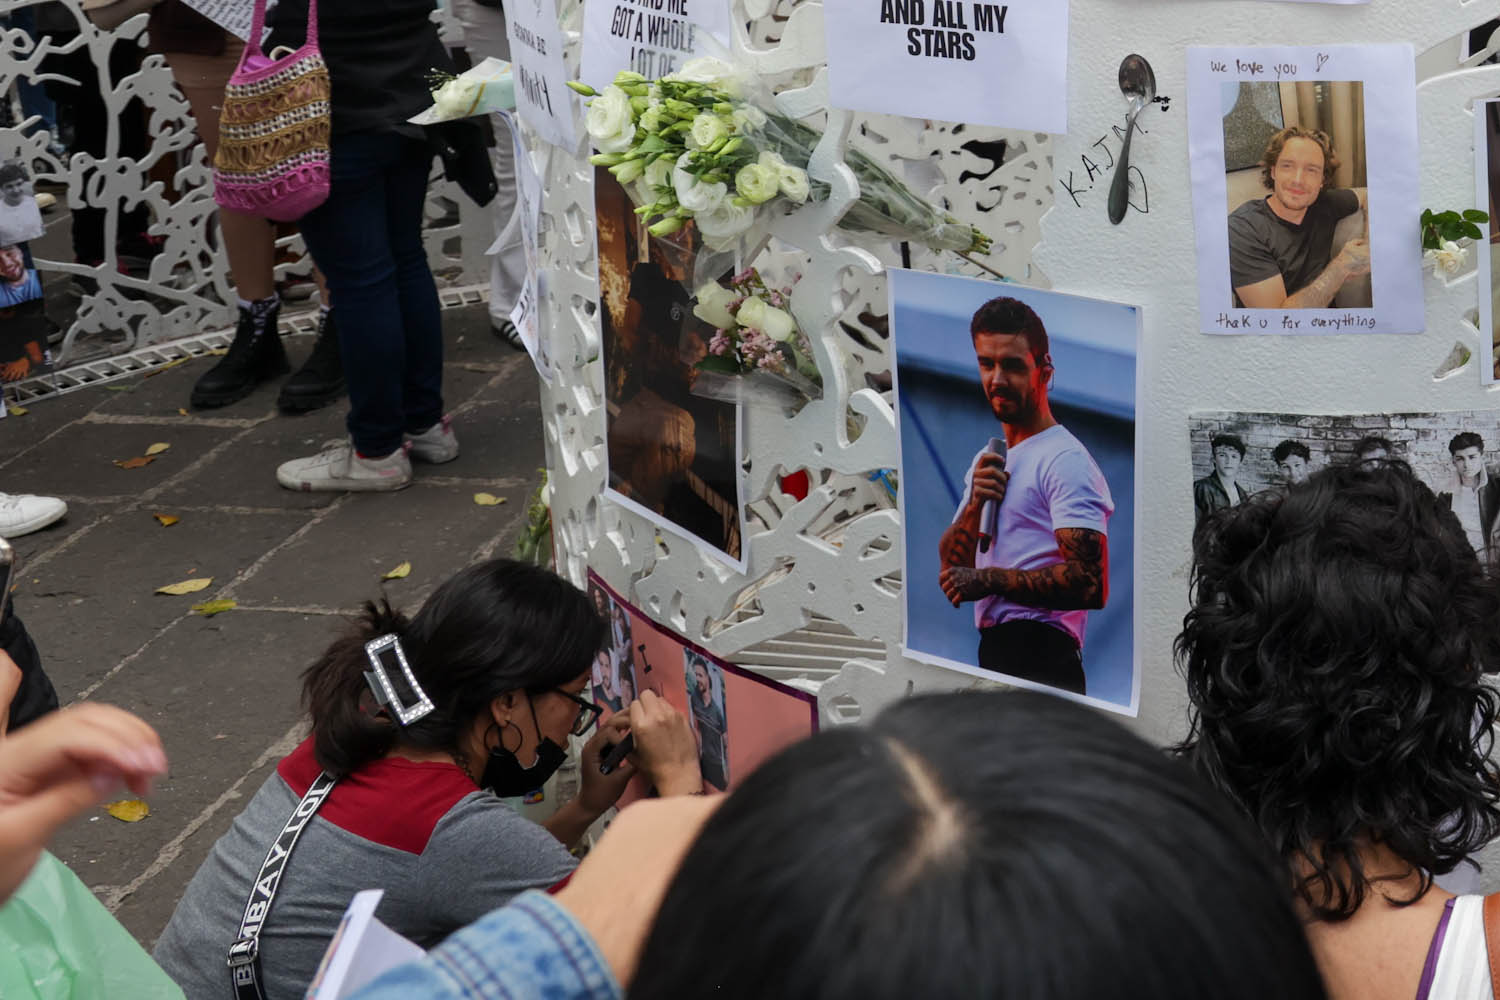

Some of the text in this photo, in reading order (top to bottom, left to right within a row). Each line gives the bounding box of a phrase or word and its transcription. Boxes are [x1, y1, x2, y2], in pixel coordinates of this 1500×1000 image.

[611, 5, 697, 54] GOT A WHOLE
[932, 0, 968, 30] ALL
[973, 3, 1008, 34] MY
[907, 27, 976, 61] STARS
[1236, 59, 1264, 75] love
[1273, 62, 1298, 80] you
[1282, 315, 1300, 329] for
[1311, 314, 1376, 330] everything
